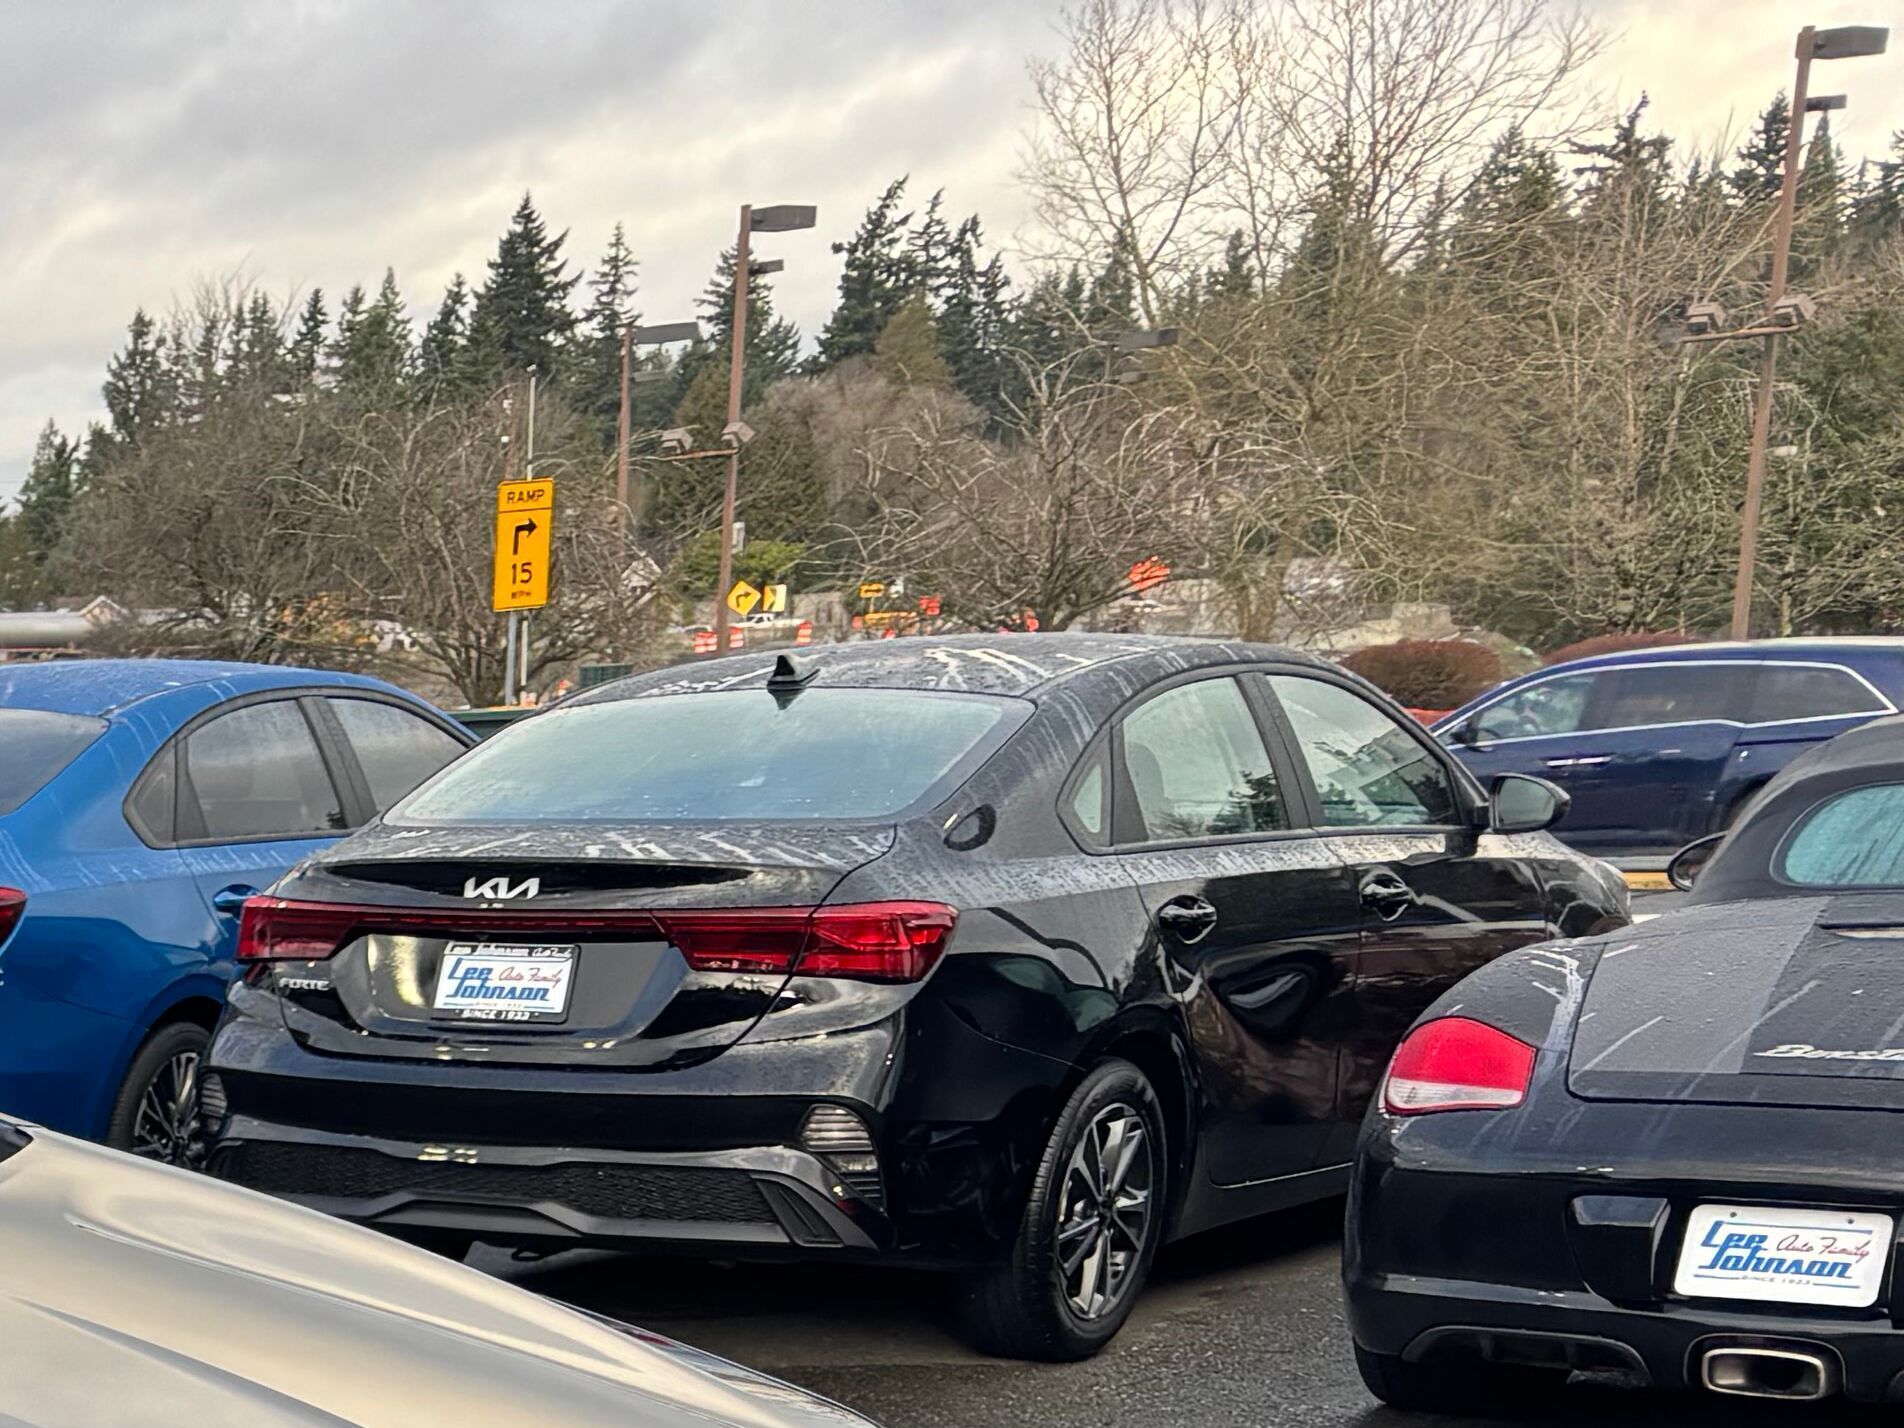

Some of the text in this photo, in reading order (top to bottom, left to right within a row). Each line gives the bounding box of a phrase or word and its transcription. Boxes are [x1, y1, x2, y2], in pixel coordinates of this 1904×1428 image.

[507, 489, 545, 505] RAMP
[512, 562, 533, 584] 15
[447, 957, 495, 981] Lee
[279, 977, 330, 991] FORTE
[445, 978, 551, 1001] Johnson
[1701, 1220, 1768, 1251] Lee
[1698, 1246, 1853, 1279] Johnson
